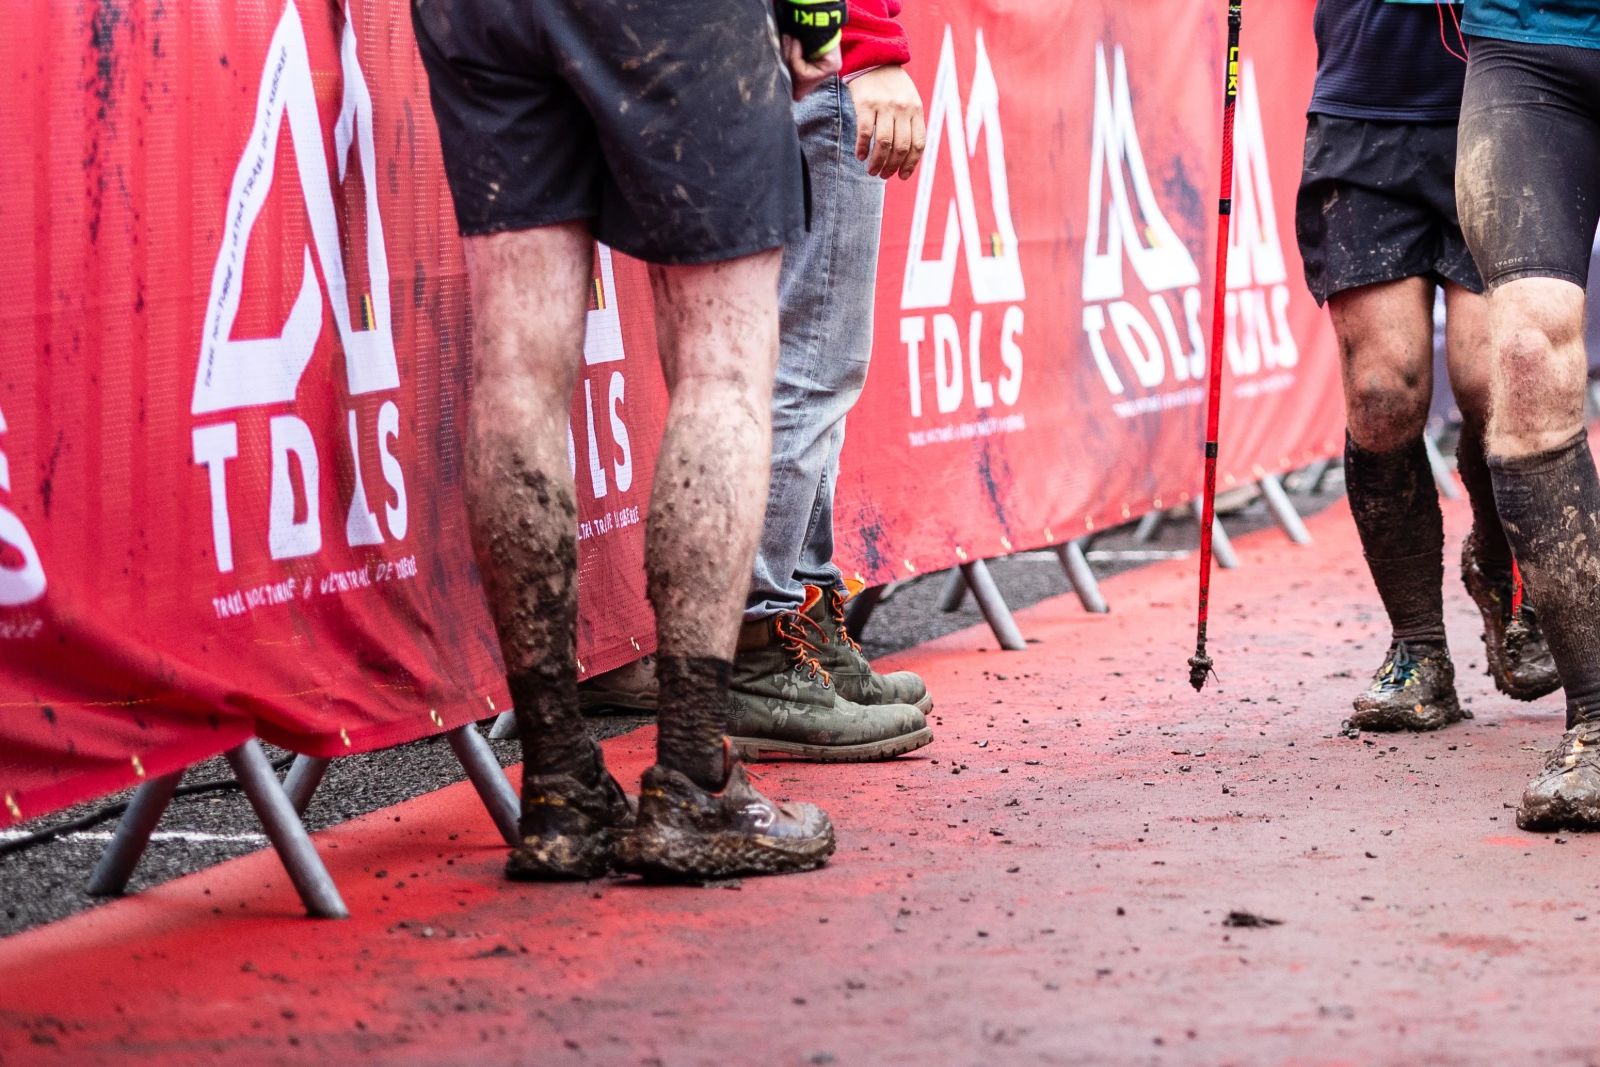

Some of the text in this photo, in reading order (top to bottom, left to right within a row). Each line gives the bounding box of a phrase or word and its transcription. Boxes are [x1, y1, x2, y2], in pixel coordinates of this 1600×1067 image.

[795, 9, 841, 26] LEKI
[1227, 47, 1239, 97] LEKI
[901, 305, 1023, 417] TDLS
[1082, 287, 1206, 395] TDLS
[192, 401, 408, 572] TDLS
[568, 370, 633, 498] LS
[574, 520, 594, 540] LTRA
